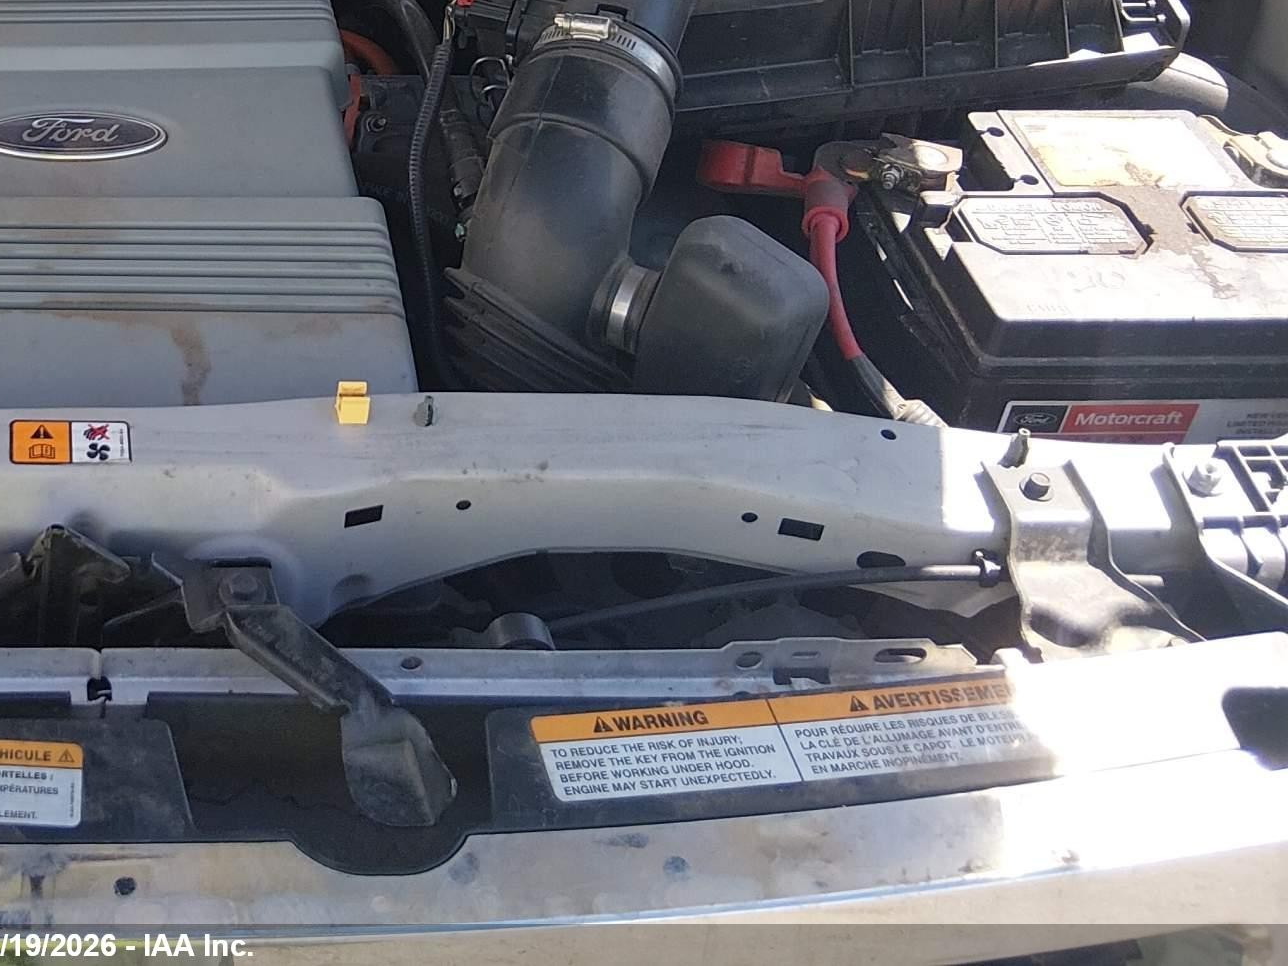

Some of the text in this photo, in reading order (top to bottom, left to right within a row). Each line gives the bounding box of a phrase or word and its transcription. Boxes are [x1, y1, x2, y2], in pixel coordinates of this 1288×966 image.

[22, 117, 119, 142] Ford
[1074, 411, 1182, 426] Motorcraft
[612, 709, 708, 731] WARNING
[794, 726, 827, 739] POUR
[831, 722, 880, 736] RÉDUIRE
[884, 719, 905, 731] LES
[909, 715, 956, 729] RISQUES
[960, 713, 975, 724] DE
[551, 748, 567, 759] TO
[570, 744, 619, 757] REDUCE
[620, 742, 644, 753] THE
[649, 739, 675, 751] RISK
[679, 738, 694, 748] OF
[801, 739, 816, 750] LA
[820, 737, 840, 748] CLÉ
[844, 735, 859, 746] DE
[863, 729, 934, 745] L'ALLUMAGE
[938, 725, 974, 738] AVANT
[805, 748, 857, 763] TRAVAUX
[862, 745, 893, 758] SOUS
[896, 743, 912, 755] LE
[961, 737, 976, 749] LE
[556, 744, 775, 770] REMOVE THE KEY FROM THE IGNITION
[811, 763, 827, 775] EN
[831, 758, 880, 773] MARCHE
[560, 758, 754, 784] BEFORE WORKING UNDER HOOD.
[564, 768, 775, 796] ENGINE MAY START UNEXPECTEDLY.
